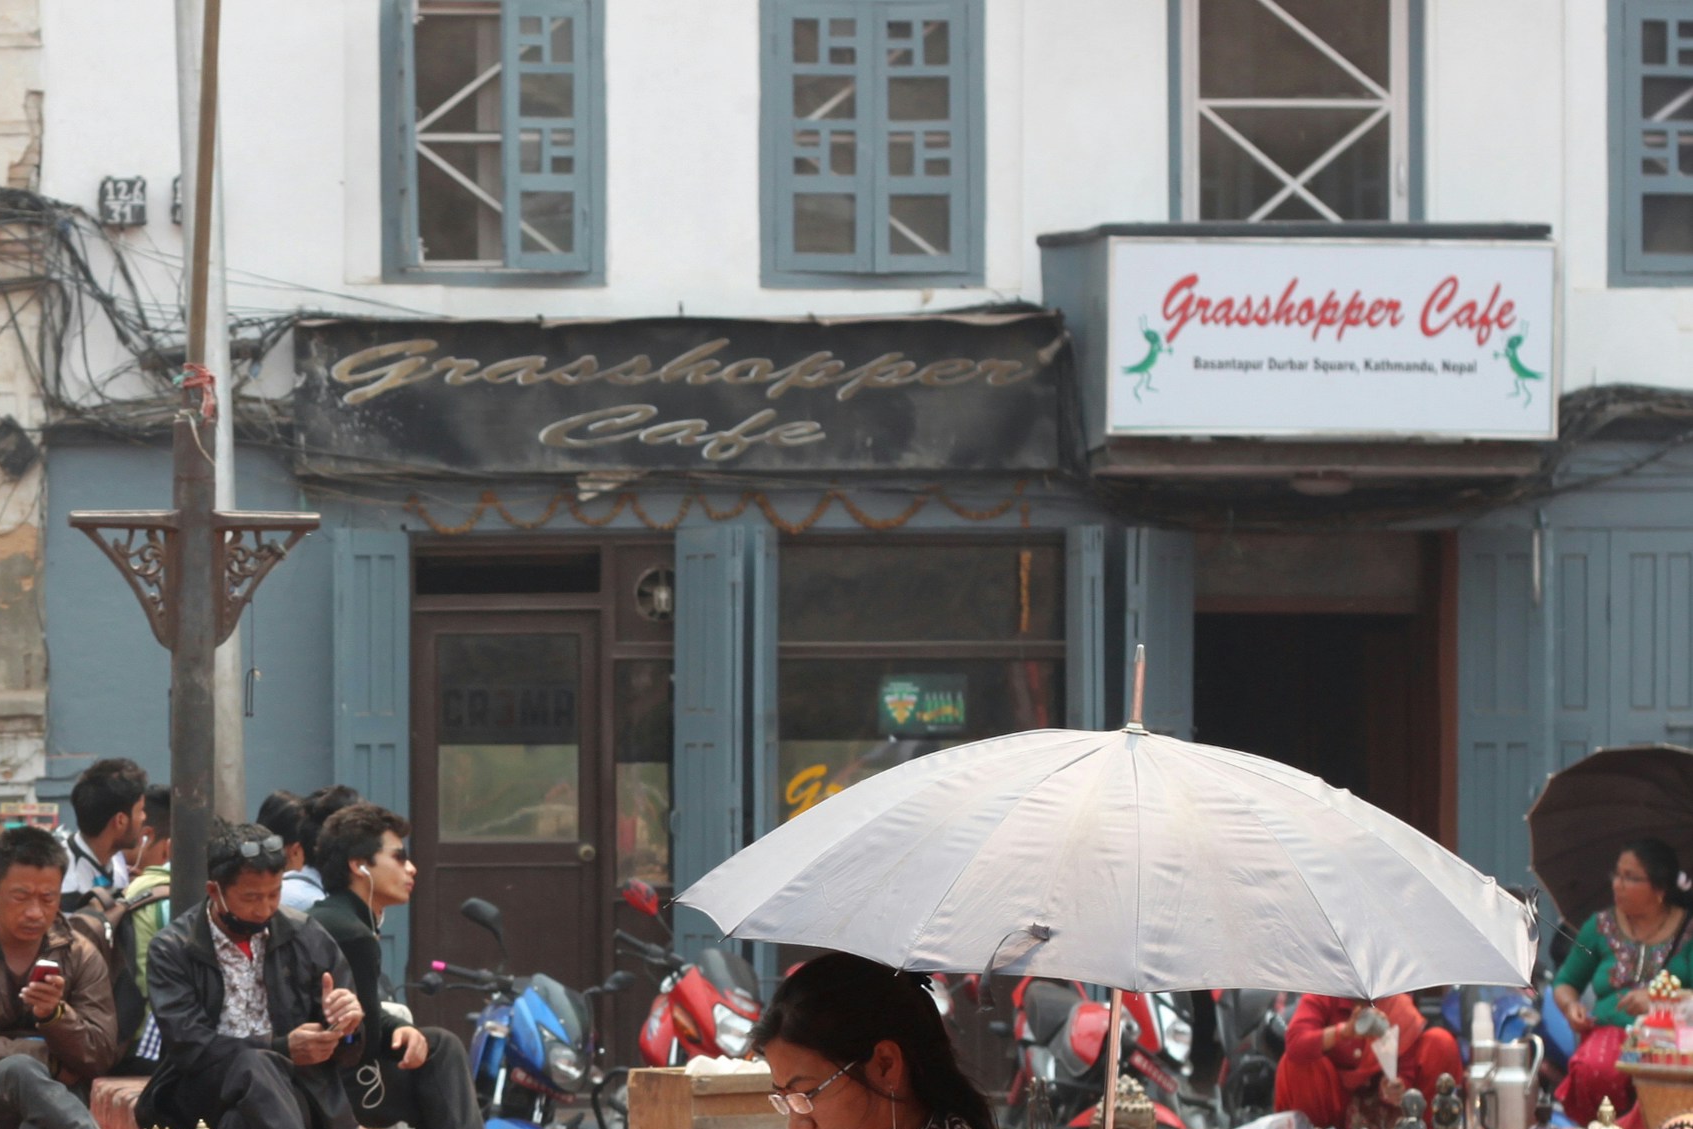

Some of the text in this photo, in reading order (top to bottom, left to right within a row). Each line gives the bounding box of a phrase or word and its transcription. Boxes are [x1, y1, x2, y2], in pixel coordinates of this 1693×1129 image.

[1161, 273, 1516, 346] Grasshopper Cafe
[329, 337, 1037, 403] Grasshopper
[1193, 356, 1478, 375] Basantapur Durbar Square, Kathmandu, Nepal
[538, 404, 827, 460] Cafe
